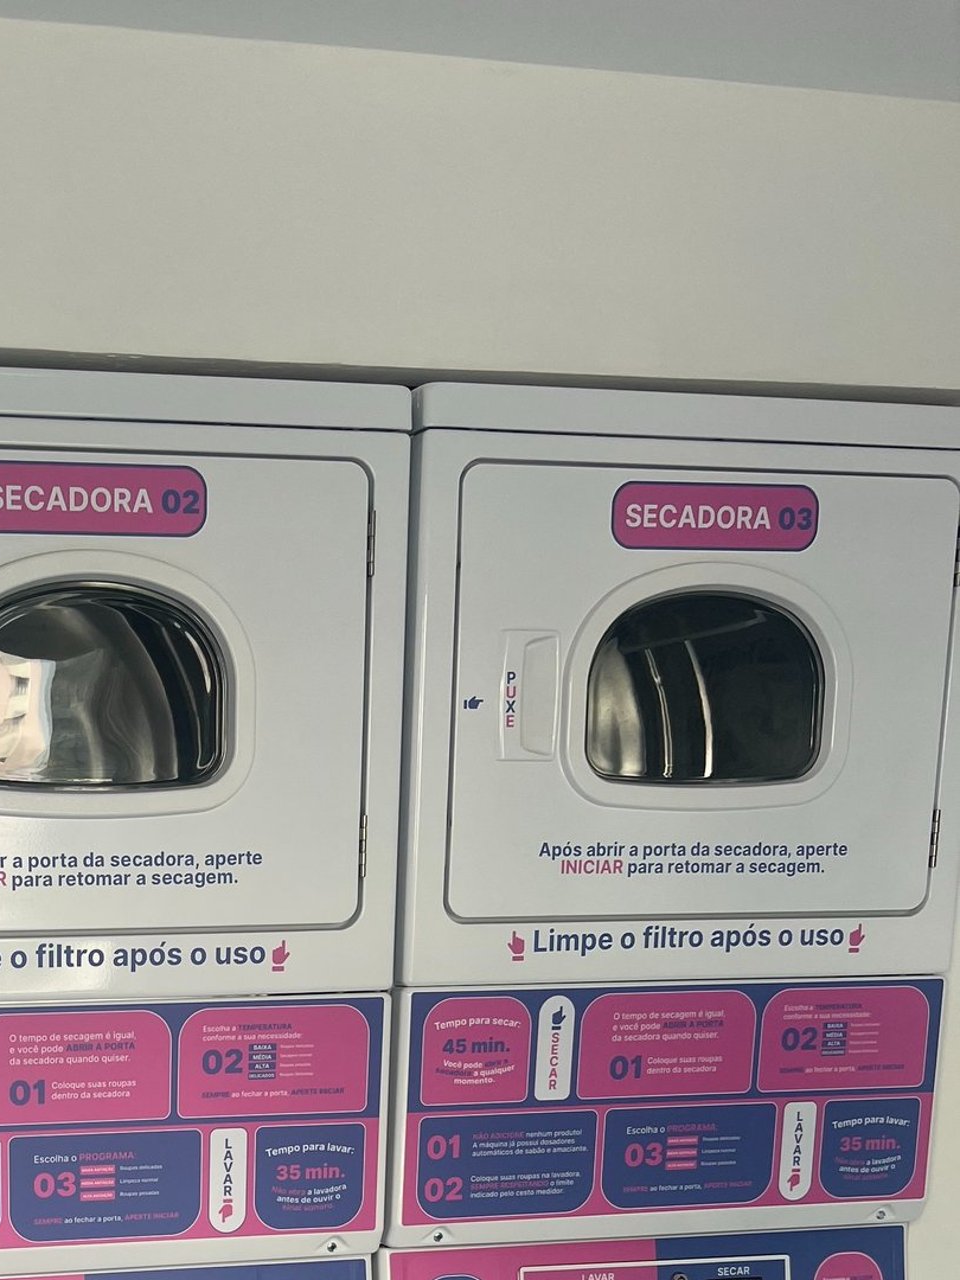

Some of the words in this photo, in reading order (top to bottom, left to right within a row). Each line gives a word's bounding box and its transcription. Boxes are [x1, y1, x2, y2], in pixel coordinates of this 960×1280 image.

[162, 490, 199, 514] 02
[626, 504, 770, 529] SECADORA
[779, 507, 812, 530] 03
[505, 671, 517, 728] PUXE
[12, 856, 23, 869] a
[29, 854, 77, 872] porta
[82, 851, 105, 868] da
[111, 851, 199, 869] secadora,
[205, 851, 262, 869] aperte
[539, 842, 581, 860] Após
[586, 841, 626, 858] abrir
[628, 845, 639, 857] a
[643, 843, 685, 860] porta
[690, 841, 710, 857] da
[715, 842, 791, 858] secadora,
[796, 843, 847, 859] aperte
[560, 859, 624, 875] INICIAR
[627, 862, 664, 878] para
[667, 860, 733, 874] retomar
[735, 862, 745, 874] a
[748, 862, 825, 877] secagem.
[12, 875, 52, 891] para
[58, 871, 132, 887] retomar
[135, 873, 147, 886] a
[152, 872, 237, 888] secagem.
[534, 929, 612, 956] Limpe
[620, 932, 636, 950] o
[643, 926, 703, 948] filtro
[711, 923, 771, 952] após
[778, 929, 793, 947] o
[801, 929, 843, 945] uso
[11, 951, 27, 968] o
[36, 943, 104, 968] filtro
[114, 941, 181, 972] após
[190, 947, 207, 966] o
[216, 947, 265, 964] uso
[442, 1038, 467, 1055] 45
[472, 1037, 510, 1053] min.
[548, 1031, 560, 1091] SECAR
[792, 1111, 804, 1167] LAVAR
[840, 1137, 862, 1153] 35
[865, 1135, 900, 1151] min.
[222, 1137, 234, 1197] LAVAR
[276, 1164, 301, 1181] 35
[306, 1163, 345, 1179] min.
[717, 1266, 750, 1277] SECAR
